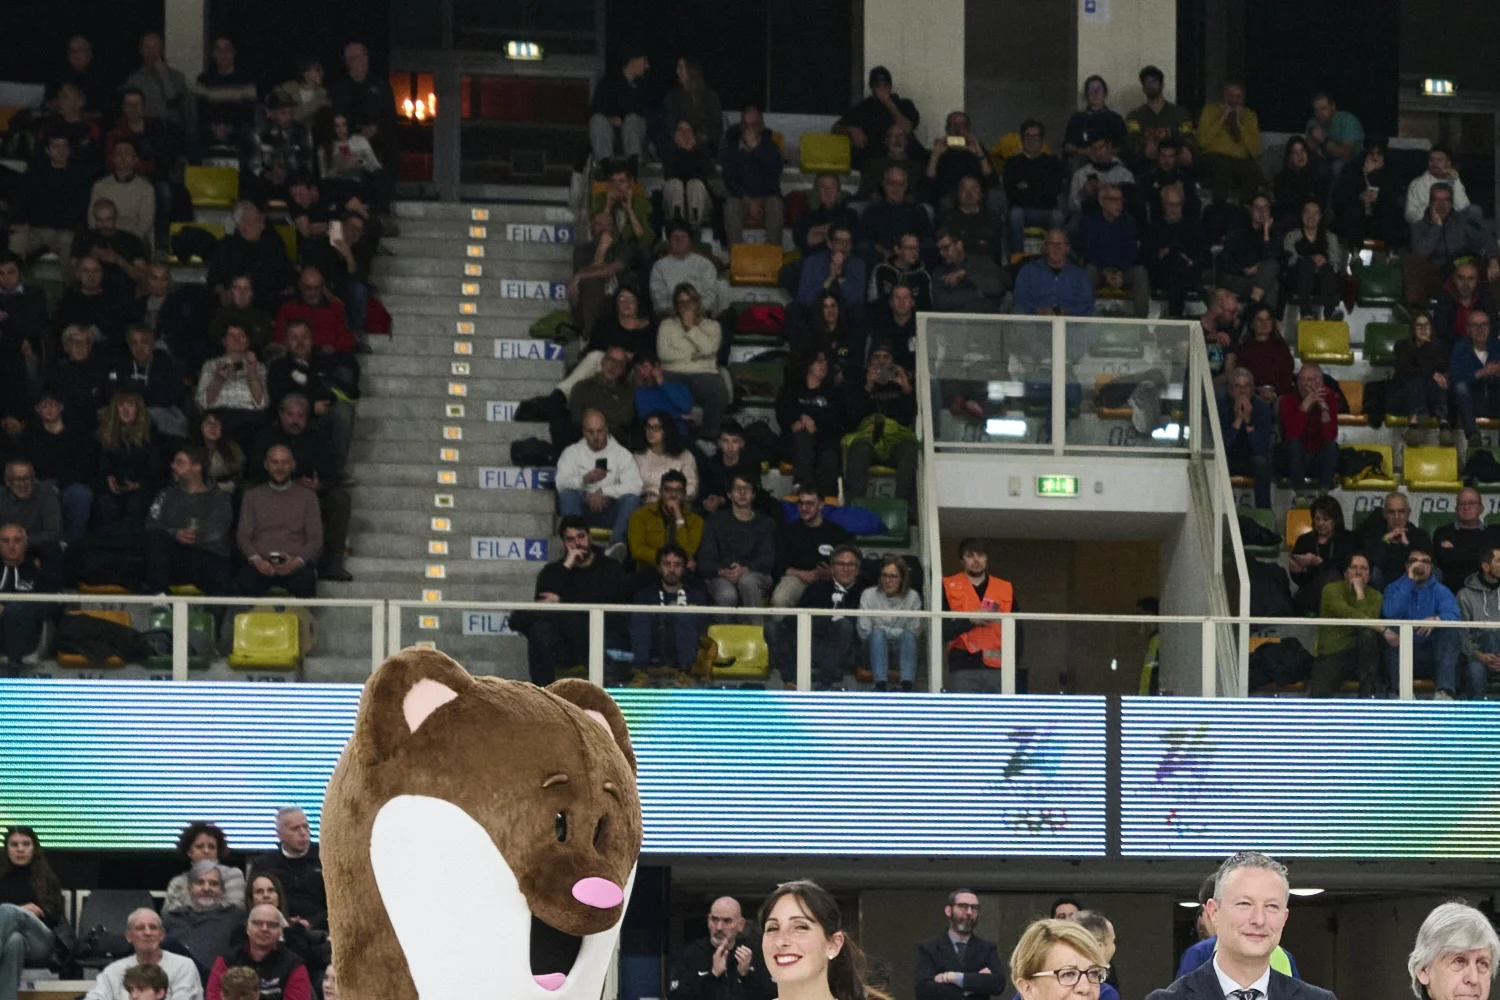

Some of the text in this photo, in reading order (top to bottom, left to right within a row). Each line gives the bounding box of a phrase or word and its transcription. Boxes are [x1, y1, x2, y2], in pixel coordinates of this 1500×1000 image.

[512, 226, 569, 240] FILA 9
[507, 283, 566, 298] FILA 8
[501, 342, 562, 358] FILA 7
[485, 471, 527, 488] FILA
[477, 541, 543, 559] FILA 4
